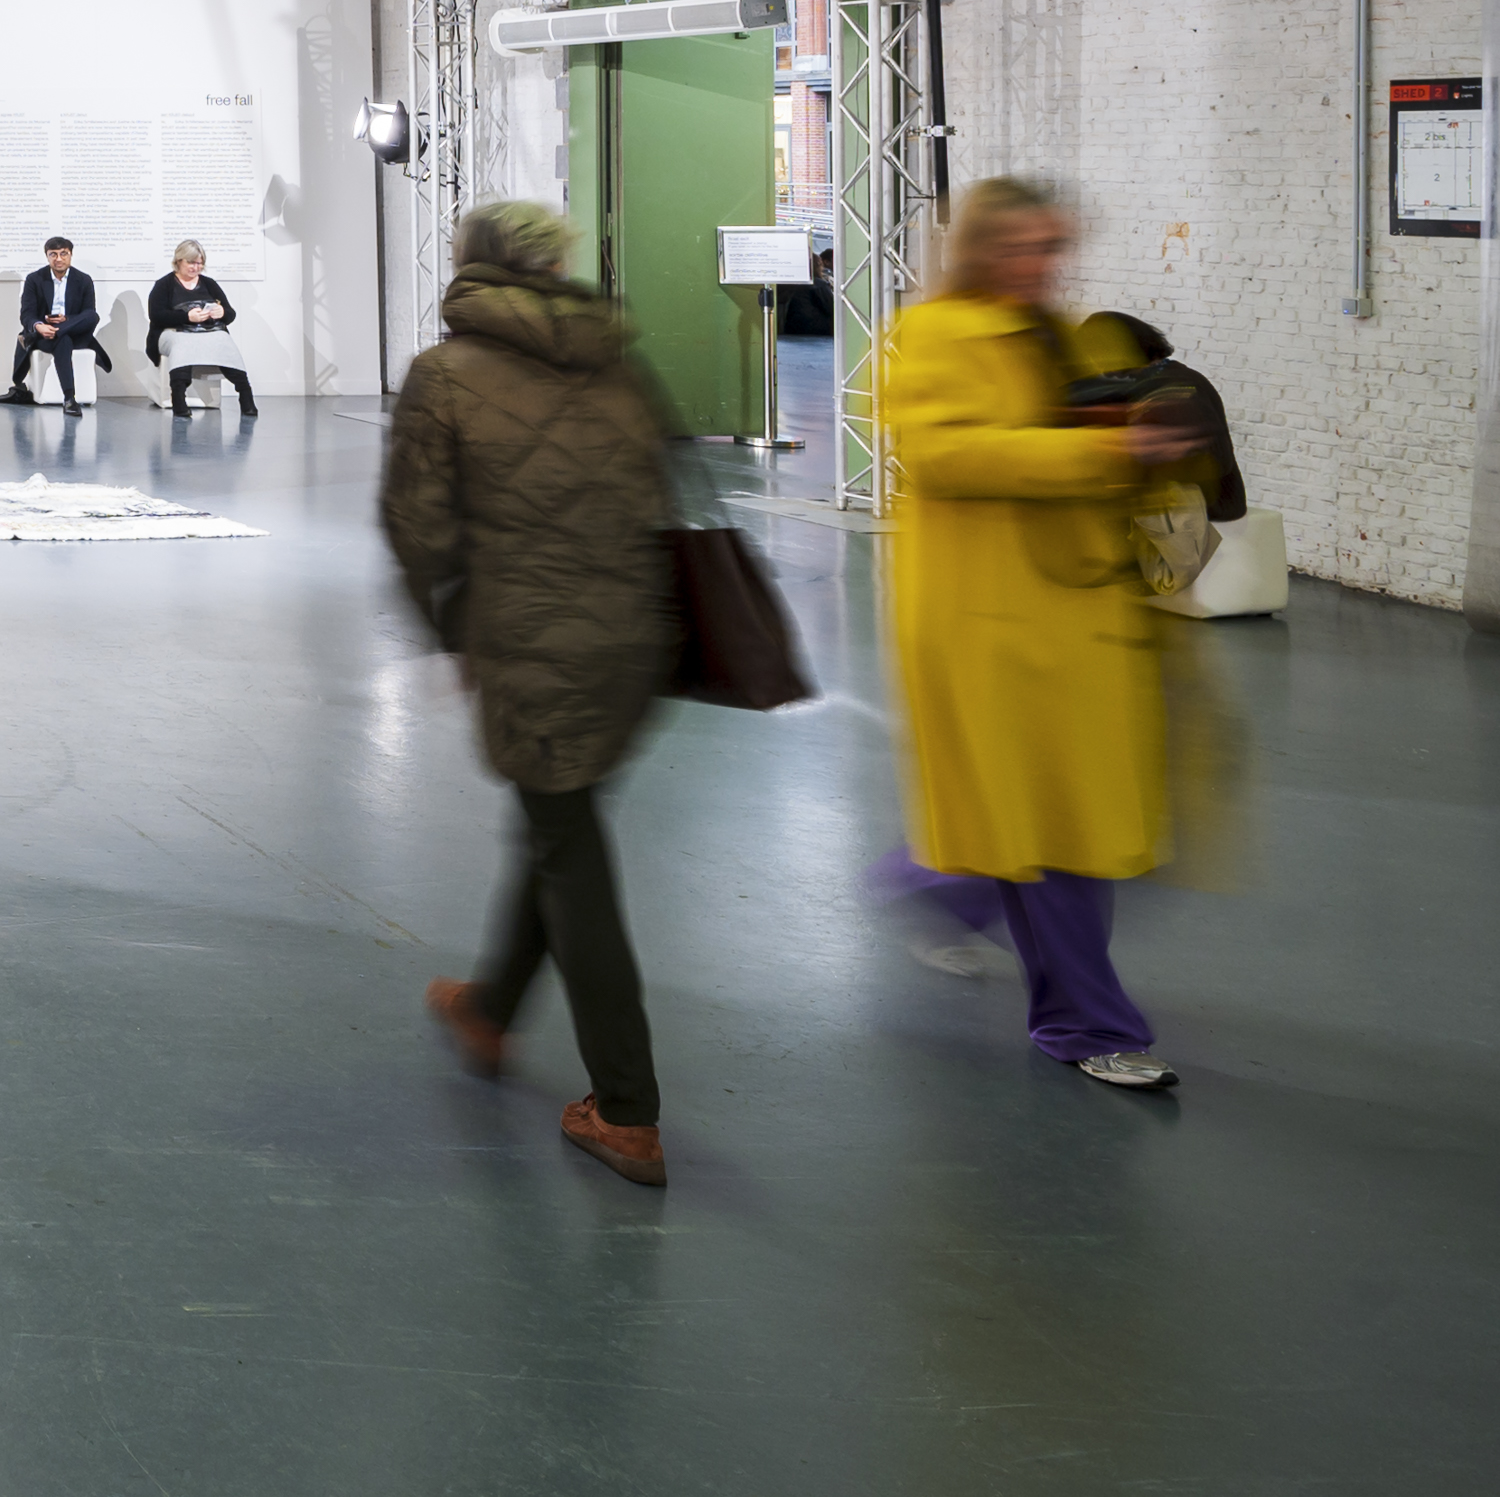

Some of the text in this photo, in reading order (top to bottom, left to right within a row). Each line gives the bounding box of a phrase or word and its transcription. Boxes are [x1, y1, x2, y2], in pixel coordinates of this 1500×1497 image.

[1393, 87, 1443, 99] SHED 2
[205, 94, 254, 106] free fall
[1433, 173, 1441, 182] 2
